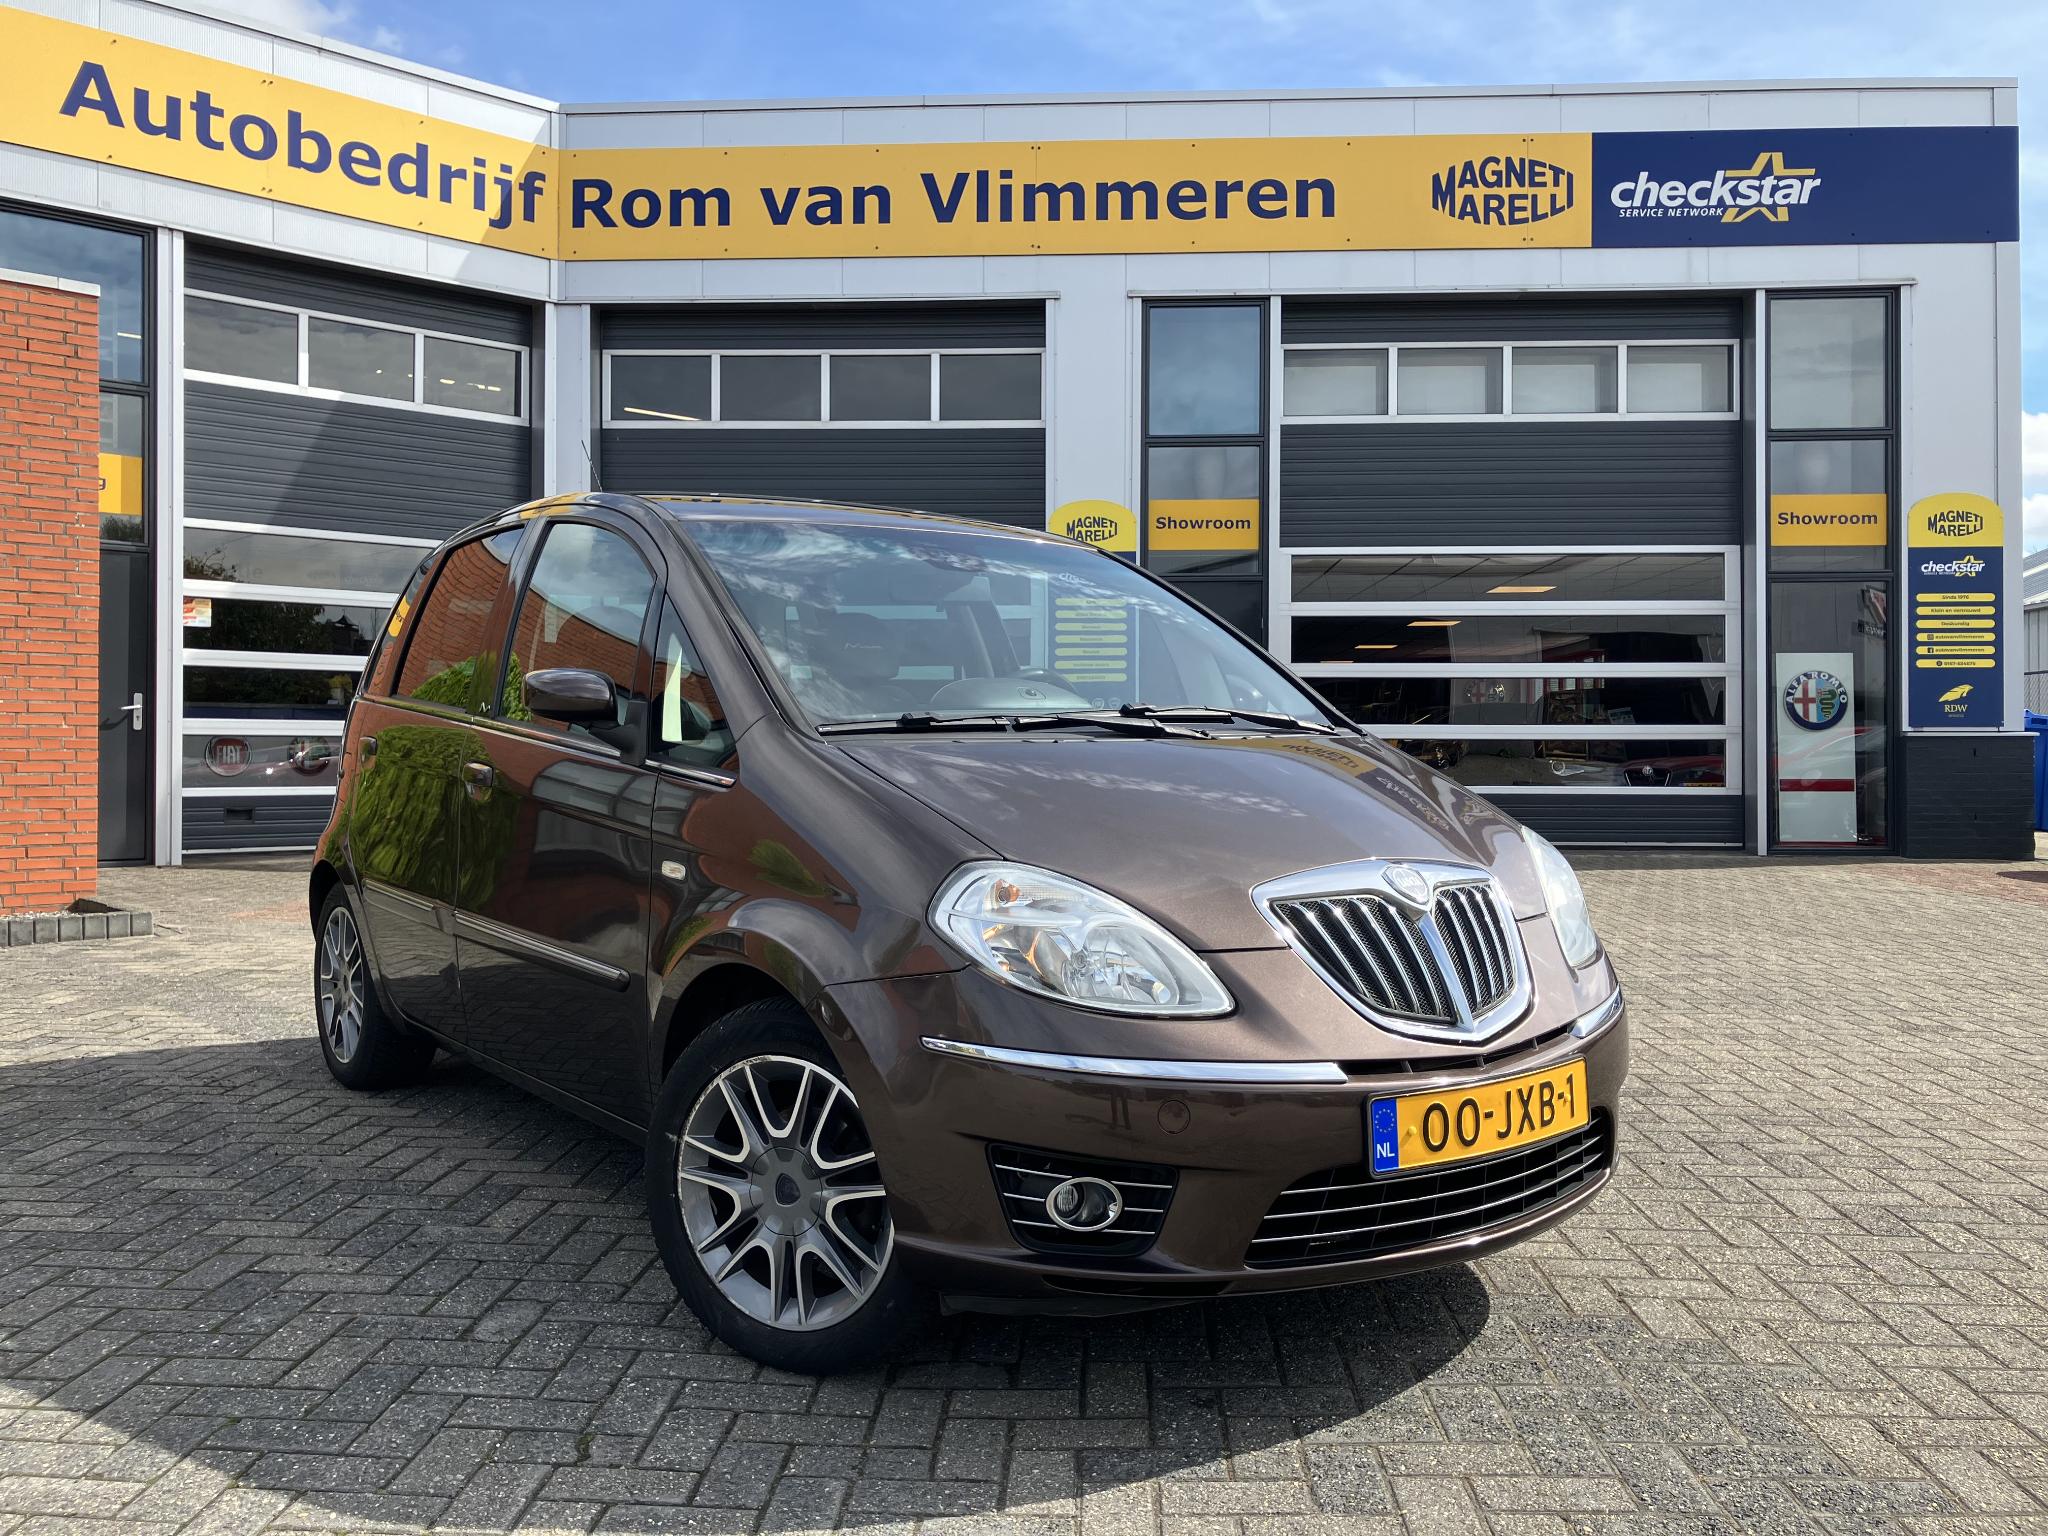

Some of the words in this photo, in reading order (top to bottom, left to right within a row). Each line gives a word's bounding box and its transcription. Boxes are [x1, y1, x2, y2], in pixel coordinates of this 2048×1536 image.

[58, 60, 547, 229] Autobedrijf
[571, 178, 731, 230] Rom
[760, 184, 892, 227] van
[919, 169, 1336, 224] Vlimmeren
[1432, 156, 1574, 204] MAGNETI
[1610, 169, 1821, 209] checkstar
[1432, 183, 1574, 226] MARELLI
[1619, 208, 1664, 218] SERVICE
[1667, 207, 1724, 217] NETWORK
[1066, 516, 1118, 533] MAGNETI
[1155, 516, 1251, 530] Showroom
[1777, 511, 1879, 526] Showroom
[1928, 510, 1983, 528] MAGNETI
[1928, 521, 1983, 537] MARELLI
[1921, 560, 1985, 573] checkstar
[1786, 674, 1808, 703] ALFA
[1811, 672, 1848, 703] ROMEO
[1944, 704, 1968, 713] RDW
[216, 745, 243, 765] FIAT
[1376, 1141, 1395, 1159] NL
